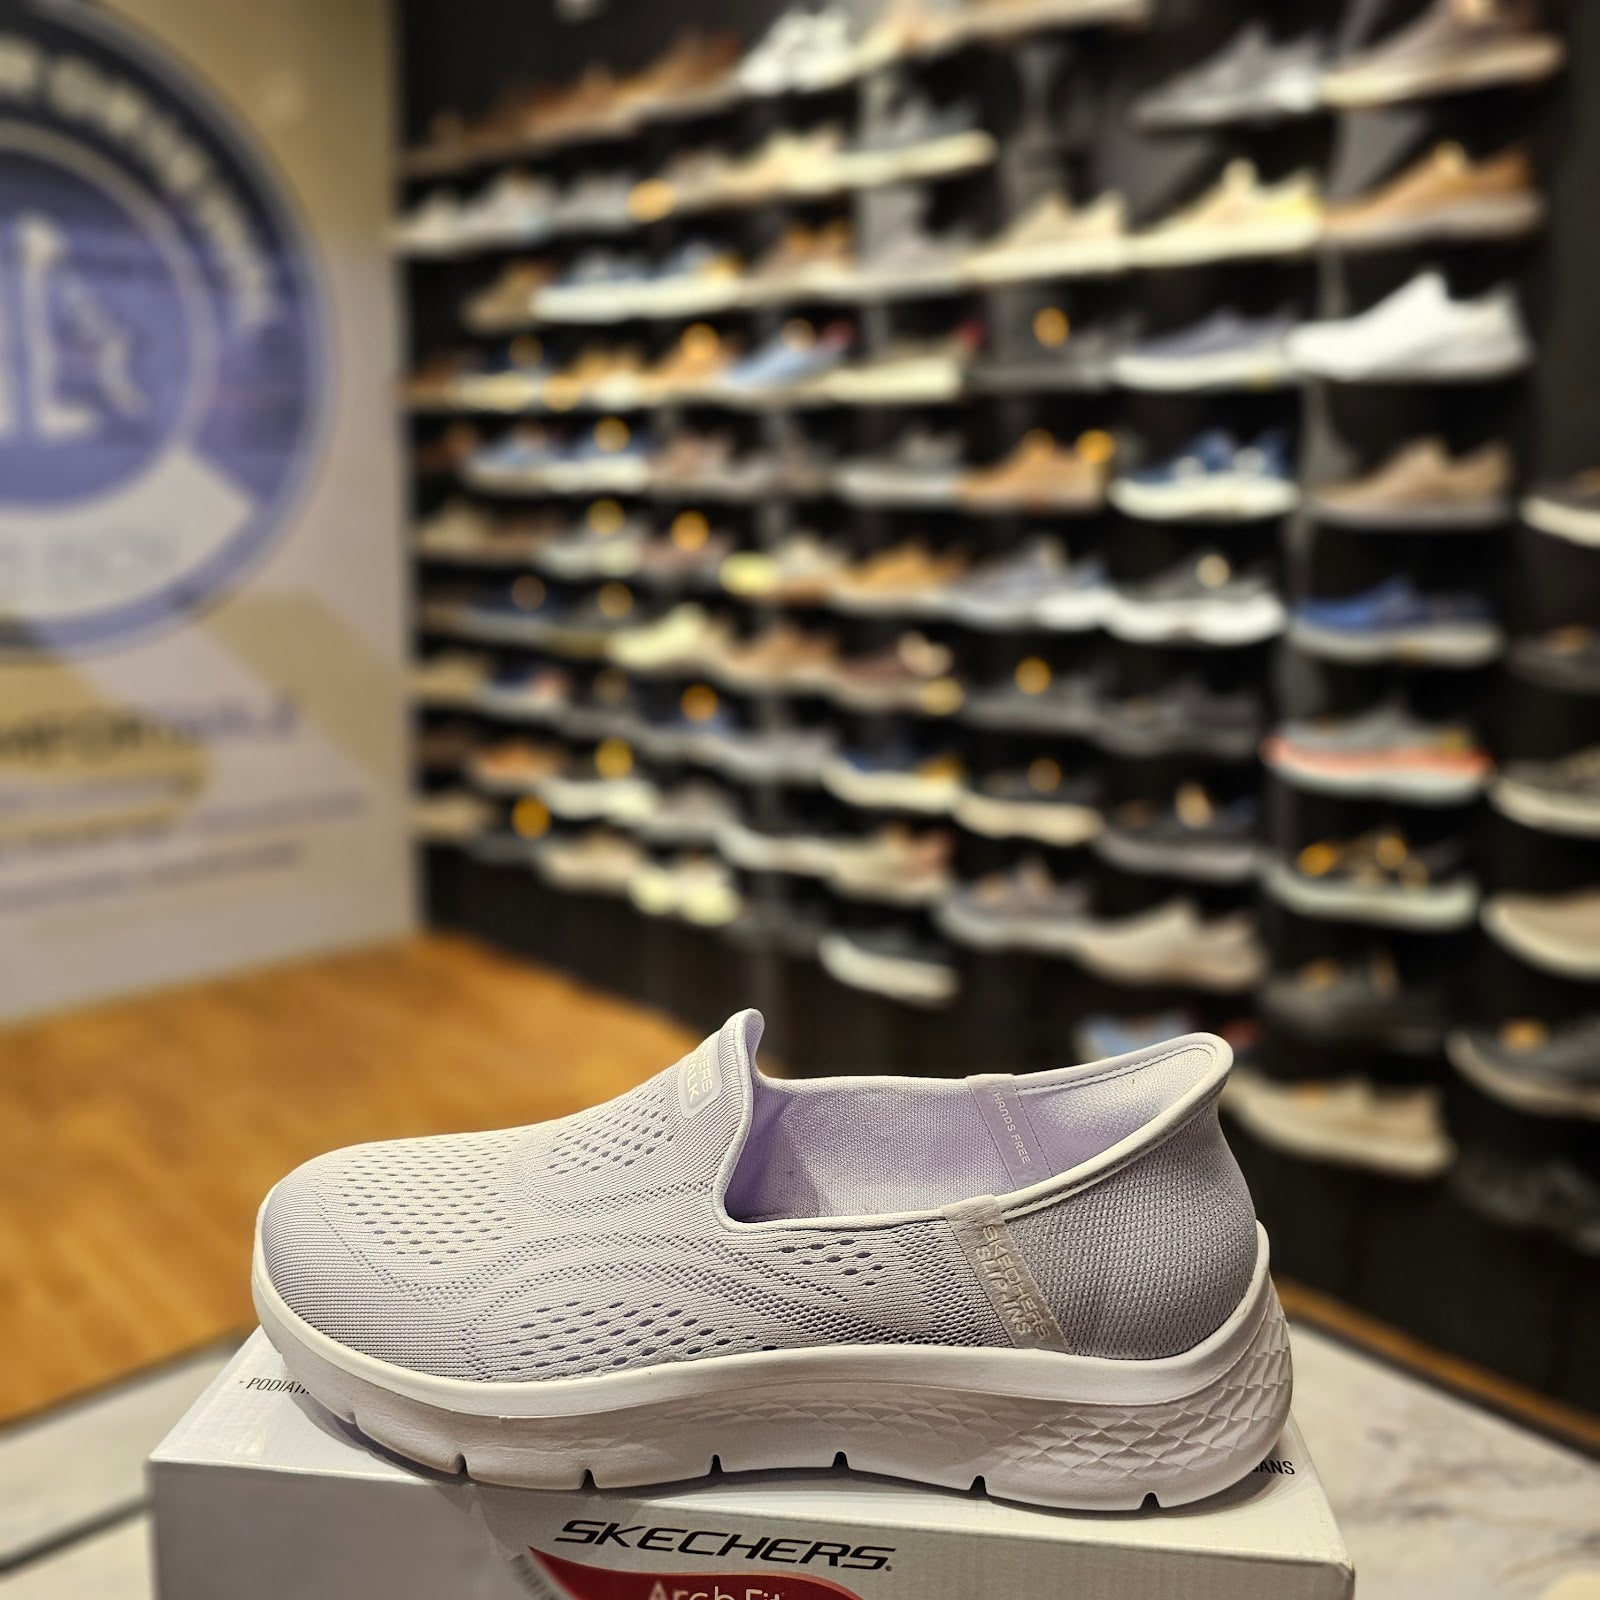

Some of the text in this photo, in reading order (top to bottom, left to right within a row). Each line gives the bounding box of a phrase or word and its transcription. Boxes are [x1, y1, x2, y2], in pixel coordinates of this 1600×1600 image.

[1012, 1133, 1031, 1164] FREE
[975, 1247, 1032, 1335] SLIP-INS
[982, 1225, 1050, 1337] SKECHERS
[245, 1377, 309, 1395] PODIAT
[1252, 1459, 1296, 1475] ANS
[553, 1519, 897, 1570] SKECHERS
